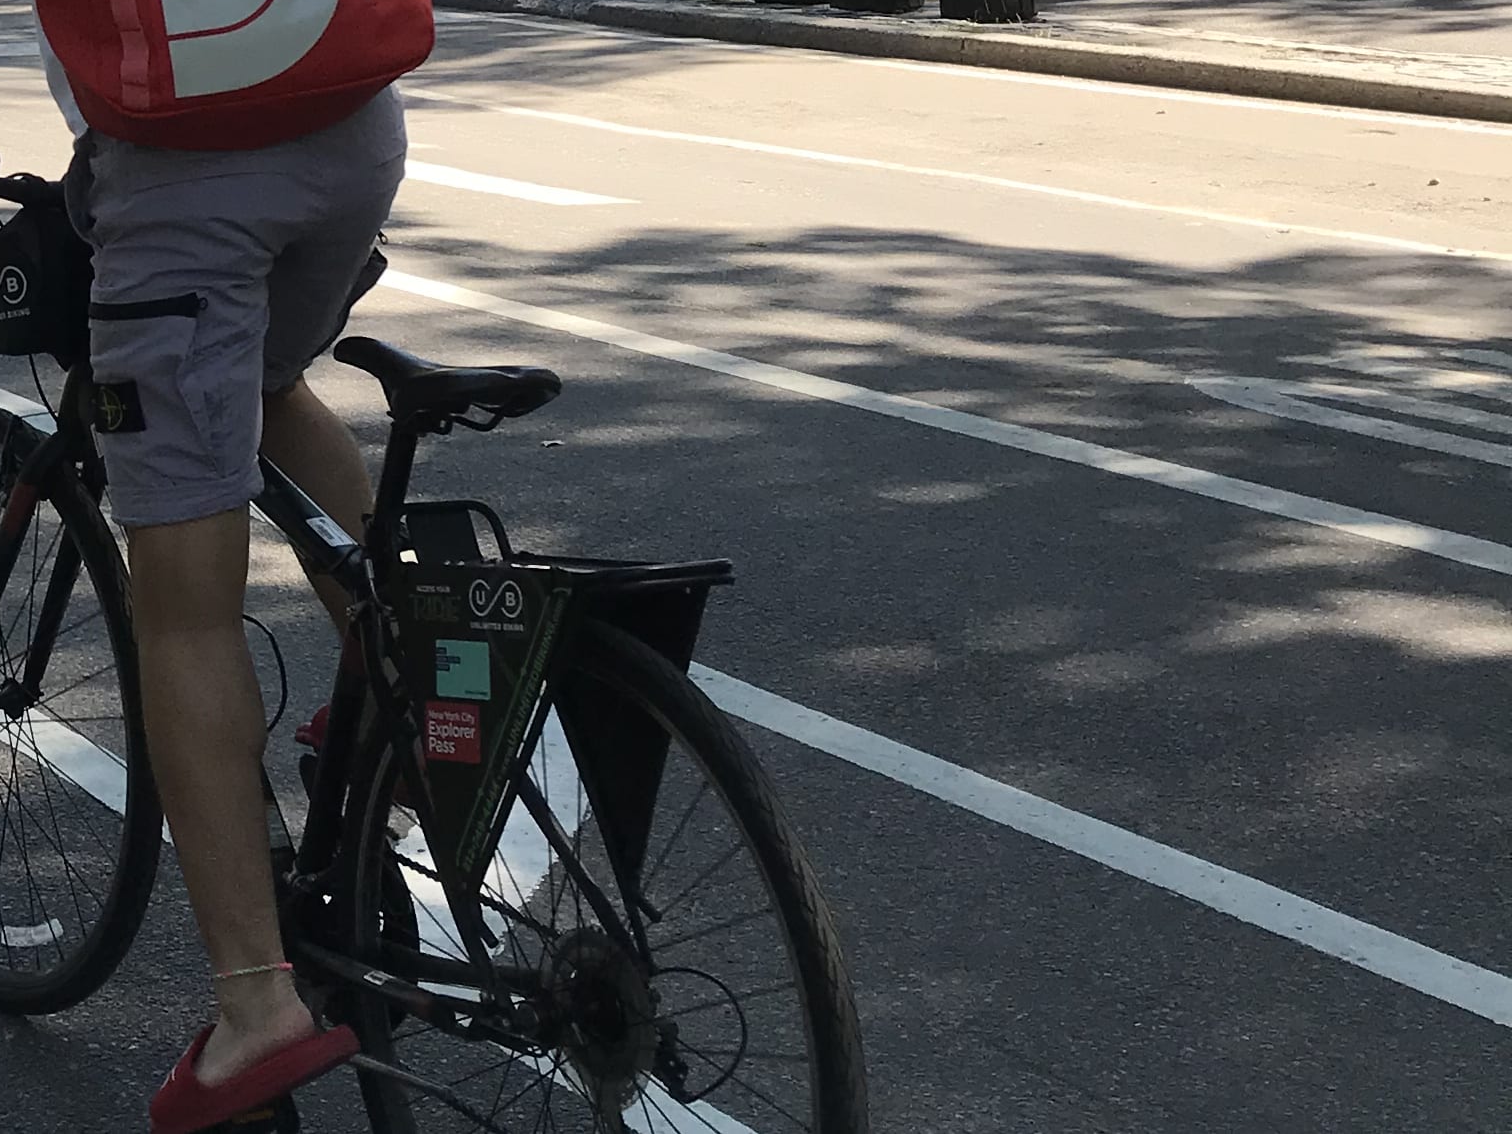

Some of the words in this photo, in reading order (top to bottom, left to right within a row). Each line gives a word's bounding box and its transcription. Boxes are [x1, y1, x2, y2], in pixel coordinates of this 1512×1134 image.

[428, 709, 444, 720] New
[444, 710, 460, 721] York
[461, 712, 475, 725] City
[428, 720, 476, 739] Explorer
[428, 736, 456, 754] Pass
